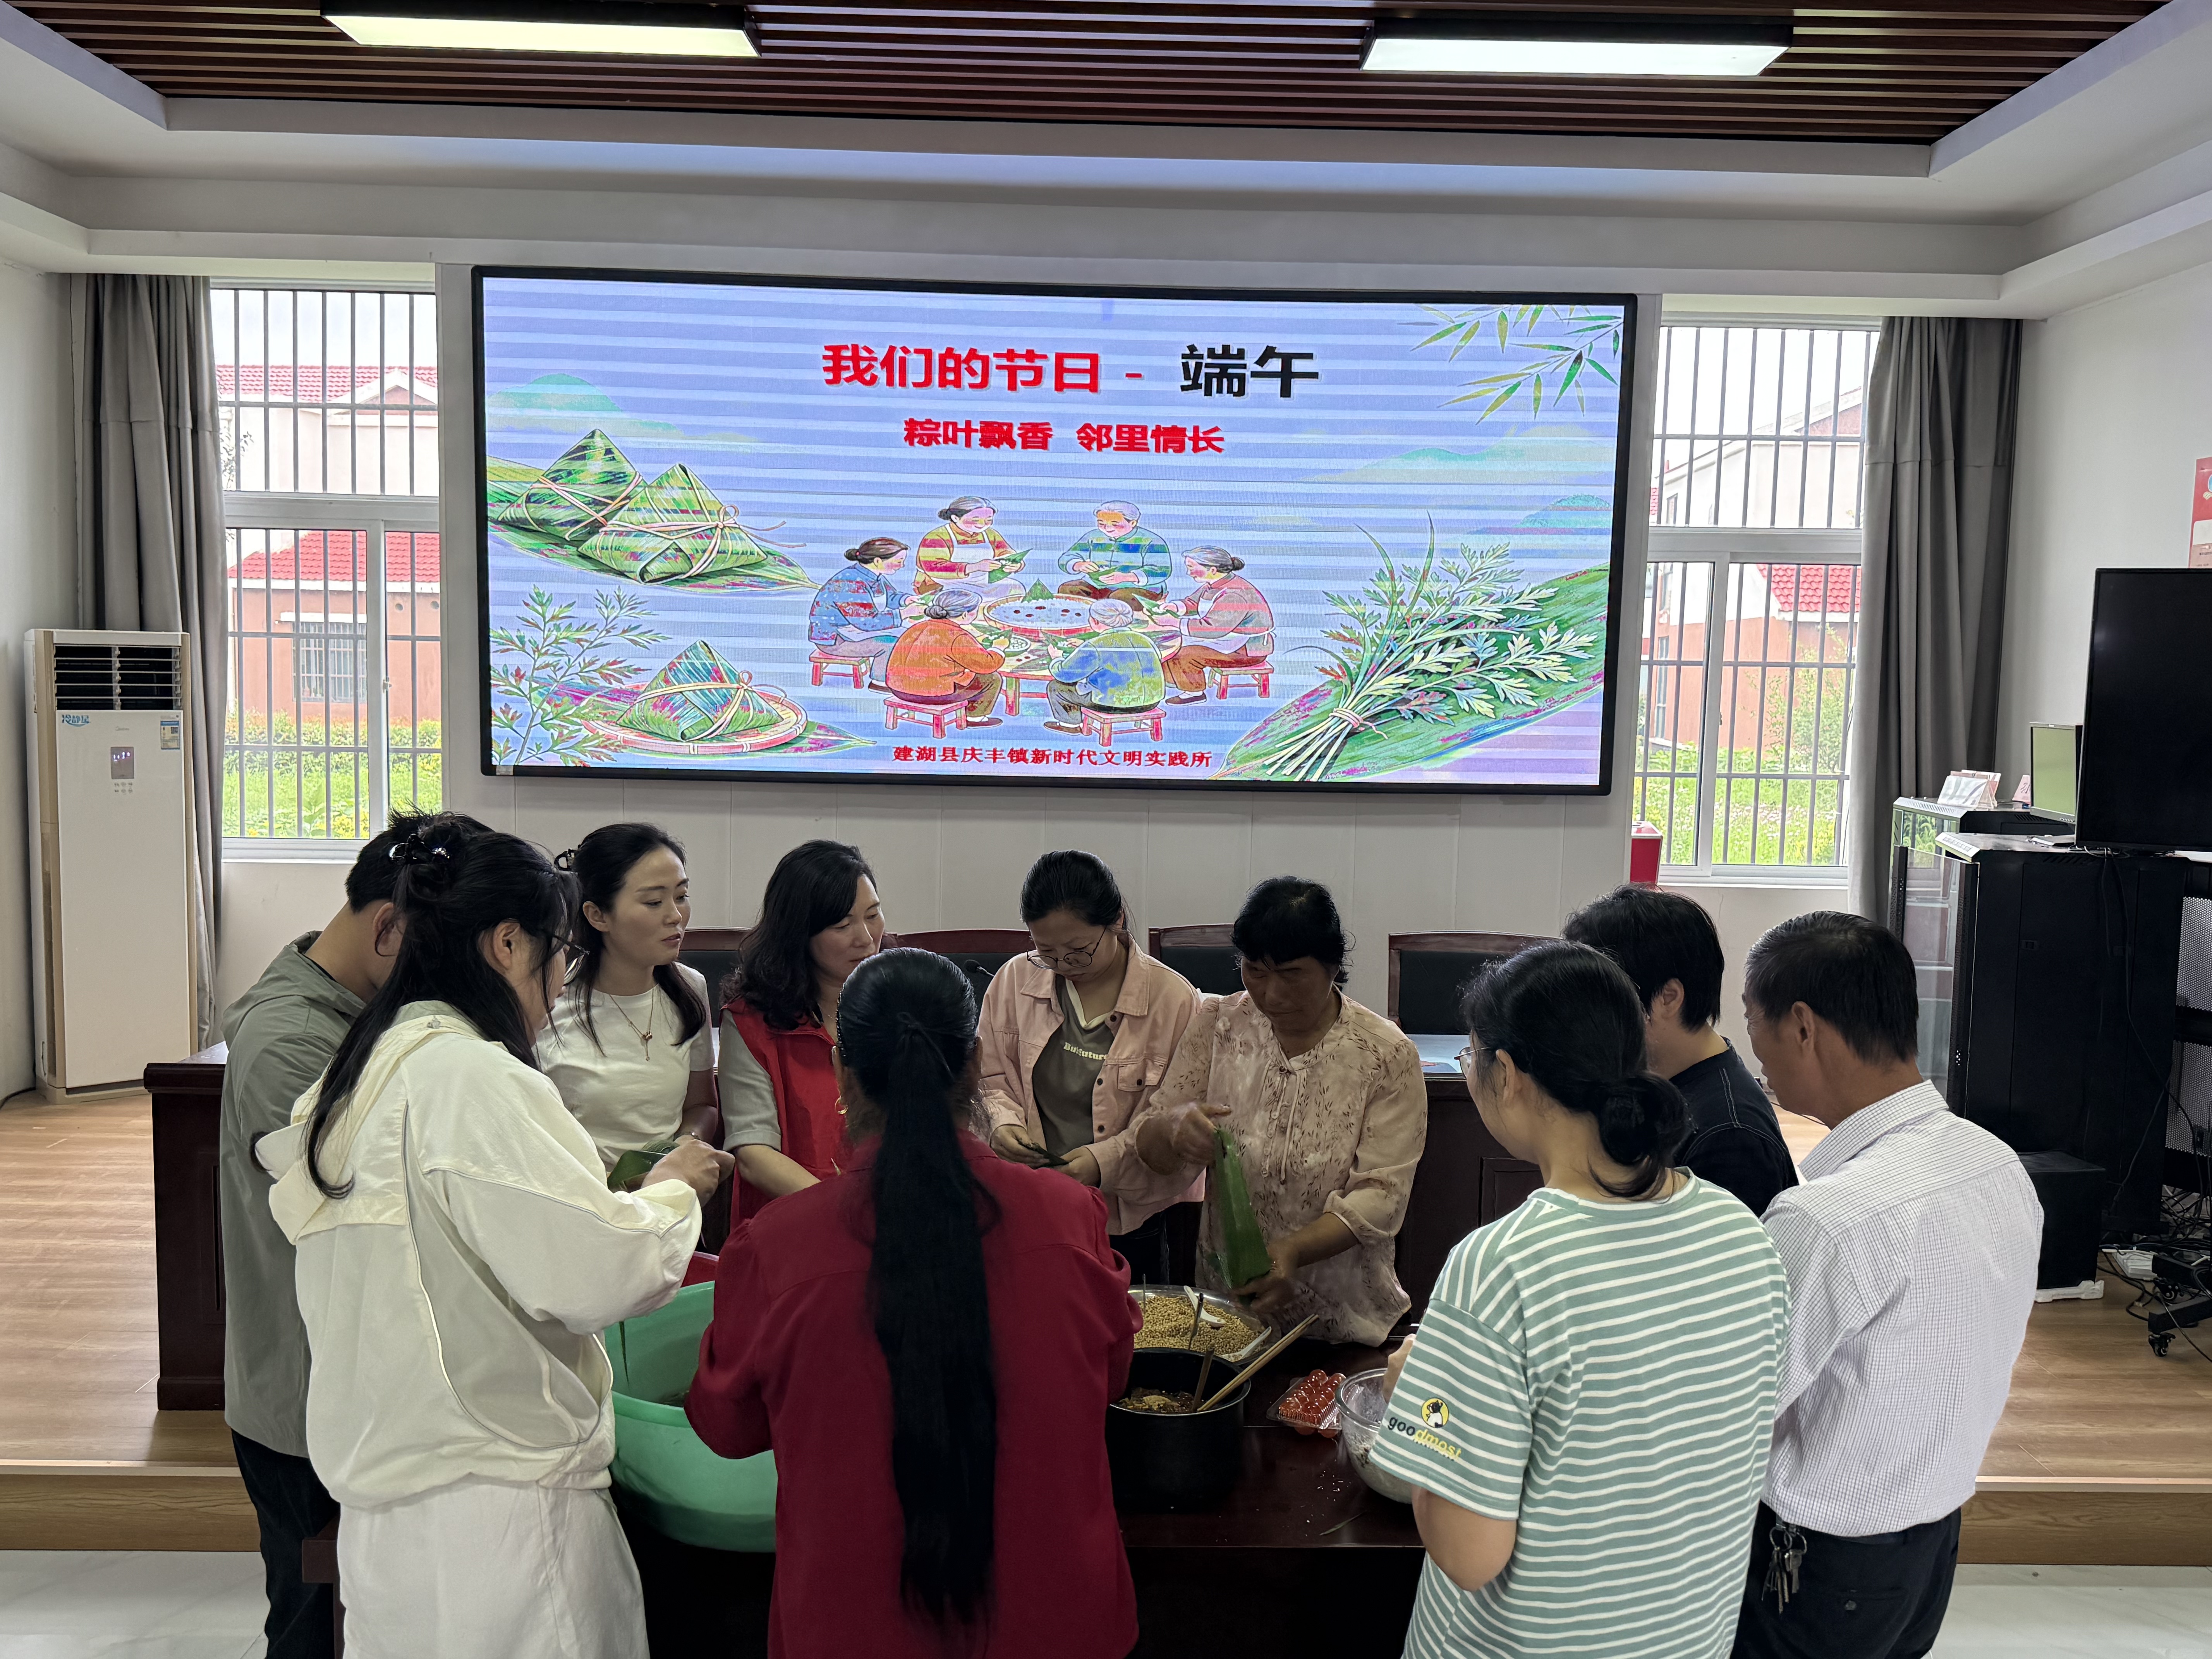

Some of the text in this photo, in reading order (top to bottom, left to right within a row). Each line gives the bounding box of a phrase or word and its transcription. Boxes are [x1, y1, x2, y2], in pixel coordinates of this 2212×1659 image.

[822, 343, 1100, 393] 我们的节日
[1180, 344, 1319, 398] 端午
[904, 418, 1225, 453] 粽叶飘香 邻里情长
[892, 745, 1213, 768] 建湖县庆丰镇新时代文明实践所
[1387, 1416, 1462, 1460] goodmost
